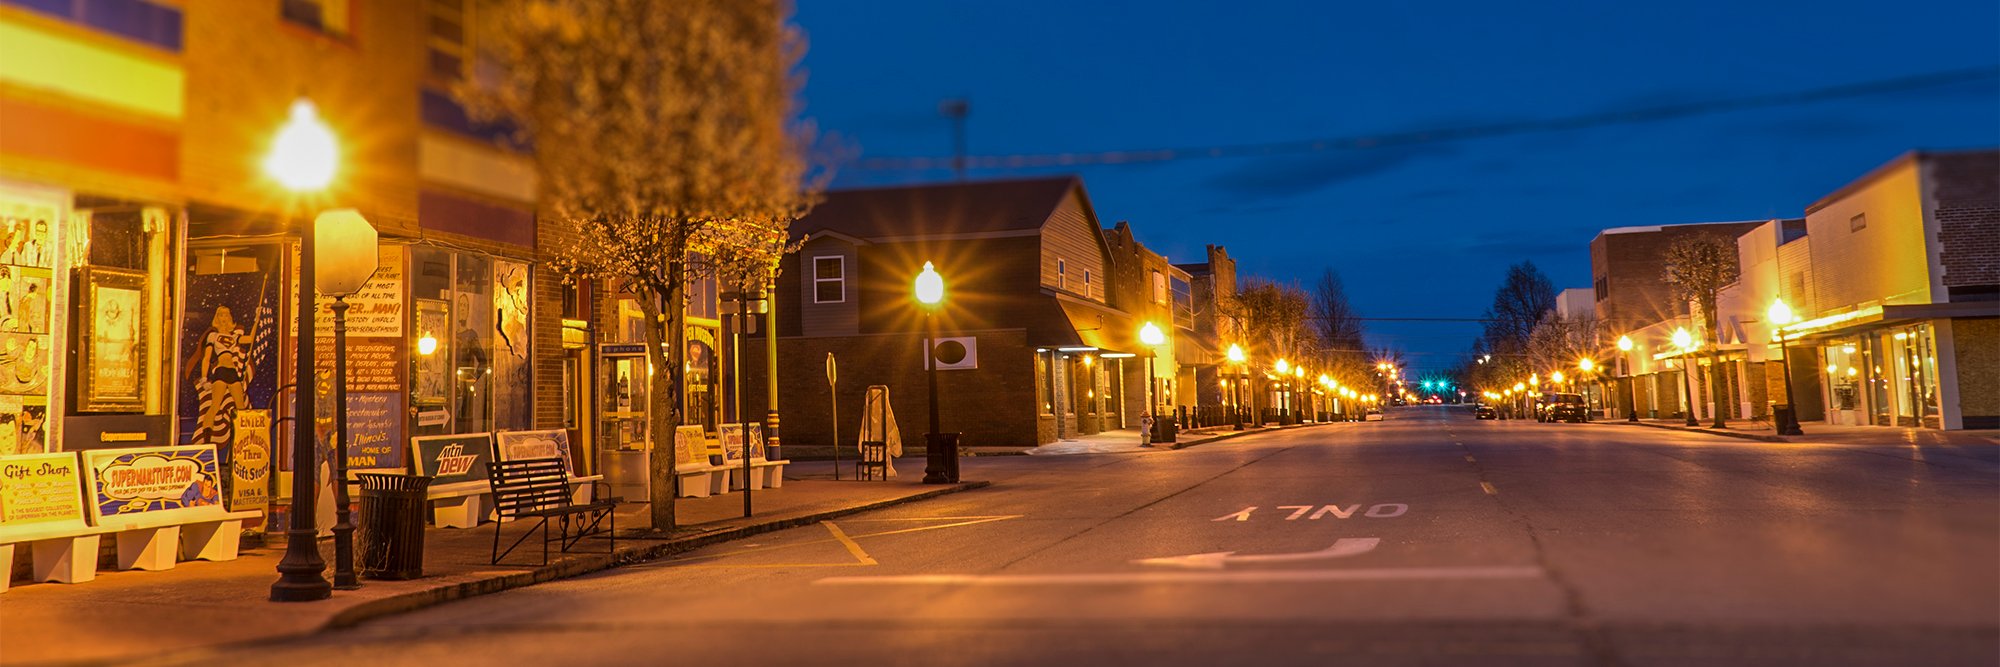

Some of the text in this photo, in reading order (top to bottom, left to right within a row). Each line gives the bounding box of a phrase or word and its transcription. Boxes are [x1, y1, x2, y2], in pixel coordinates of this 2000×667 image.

[240, 416, 265, 428] ENTER
[353, 431, 390, 447] Illinois.
[243, 449, 261, 460] Thru
[361, 446, 392, 454] HOME OF
[441, 443, 463, 459] Mtn
[4, 462, 71, 480] Gift Shop
[111, 464, 193, 489] SUPERMANSTUFF.COM
[234, 460, 269, 481] Gift Store
[238, 488, 255, 497] VISA
[233, 495, 268, 506] MASTERCARD
[45, 504, 73, 512] COLLECTION
[1210, 503, 1409, 522] ONLY
